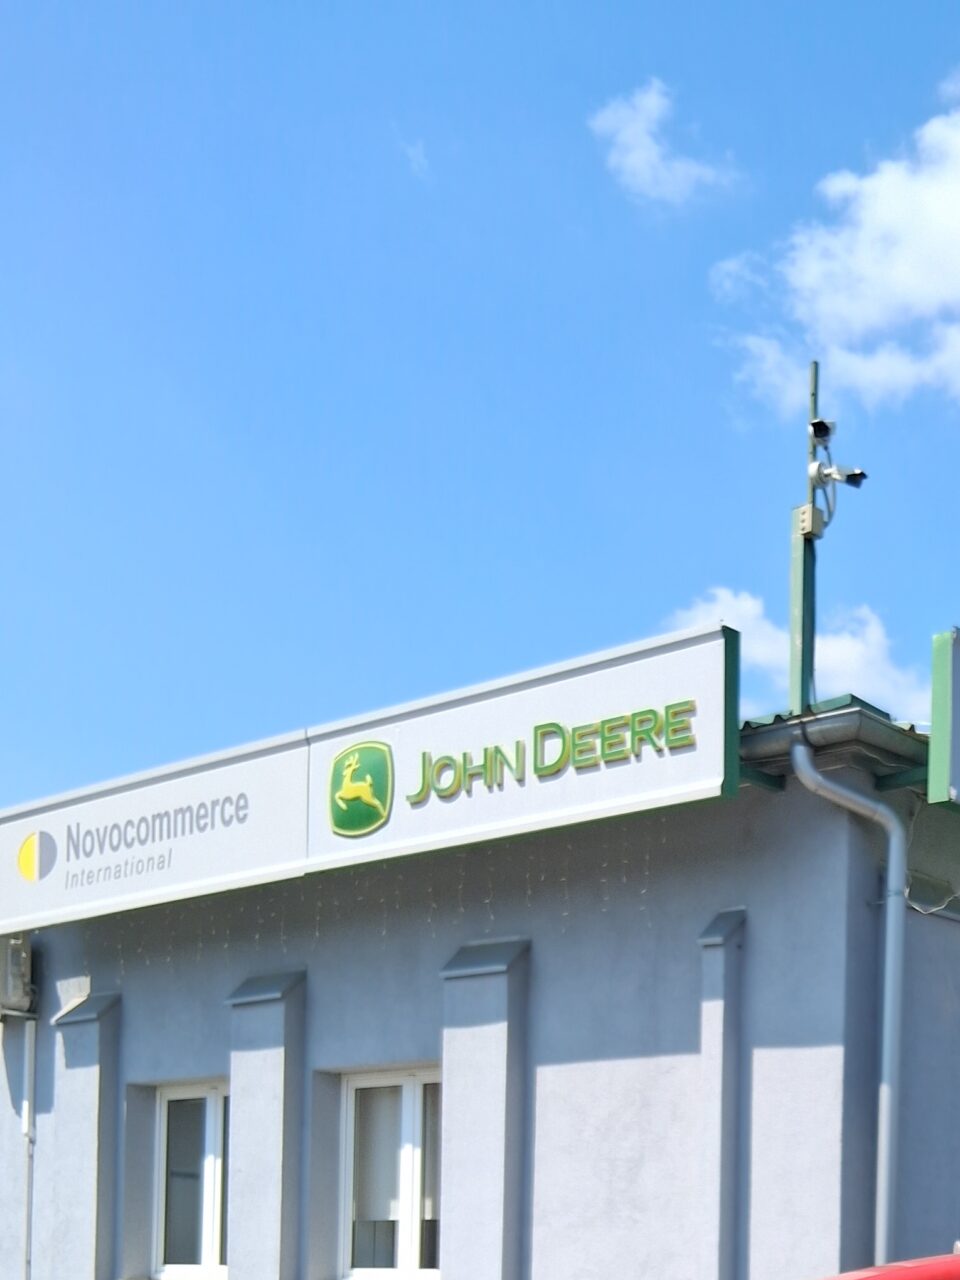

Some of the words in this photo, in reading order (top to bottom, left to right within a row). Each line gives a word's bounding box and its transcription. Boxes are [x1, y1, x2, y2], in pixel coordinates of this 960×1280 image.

[406, 738, 526, 804] JOHN
[533, 699, 697, 778] DEERE
[65, 792, 249, 862] Novocommerce
[64, 848, 173, 890] International
